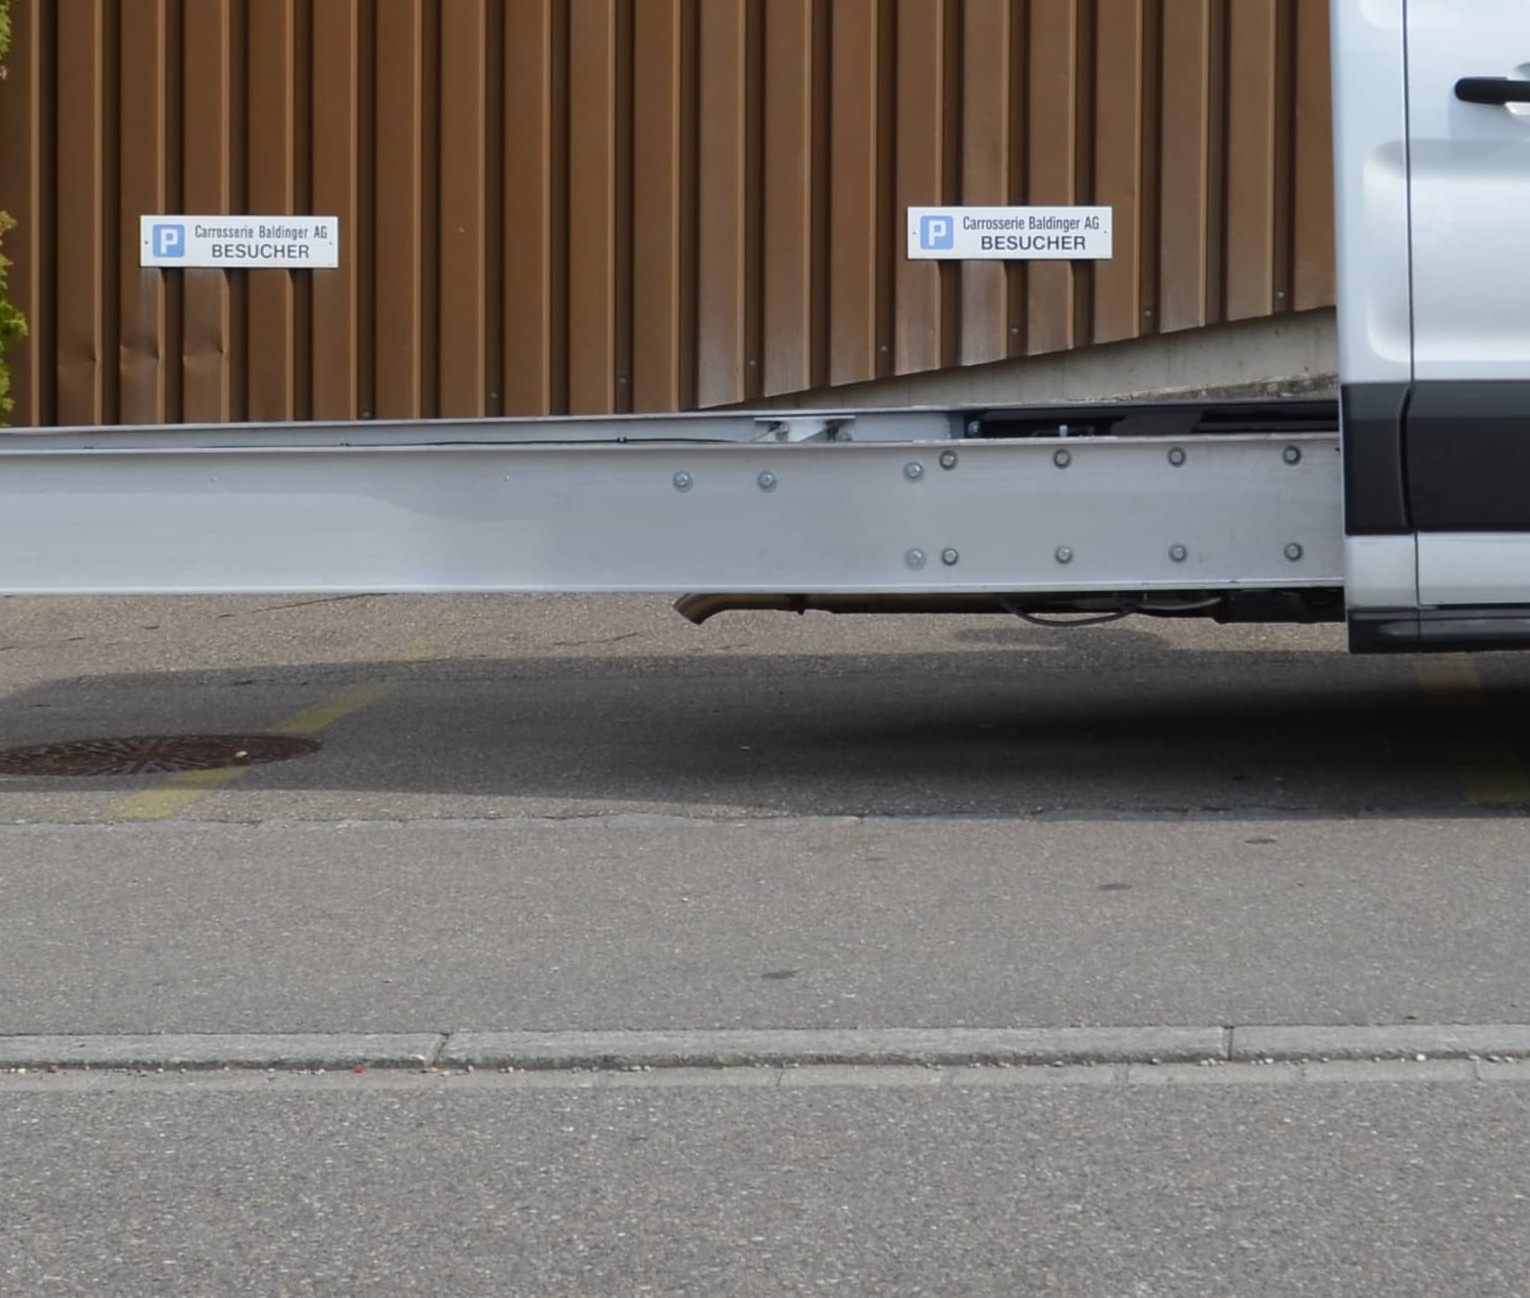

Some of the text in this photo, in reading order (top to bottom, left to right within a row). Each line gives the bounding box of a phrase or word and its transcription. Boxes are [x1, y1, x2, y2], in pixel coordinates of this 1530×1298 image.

[194, 224, 328, 241] Carrosserie Baldinger AG
[962, 215, 1100, 234] Carrosserie Baldinger AG
[211, 243, 310, 259] BESUCHER
[980, 235, 1086, 251] BESUCHER
